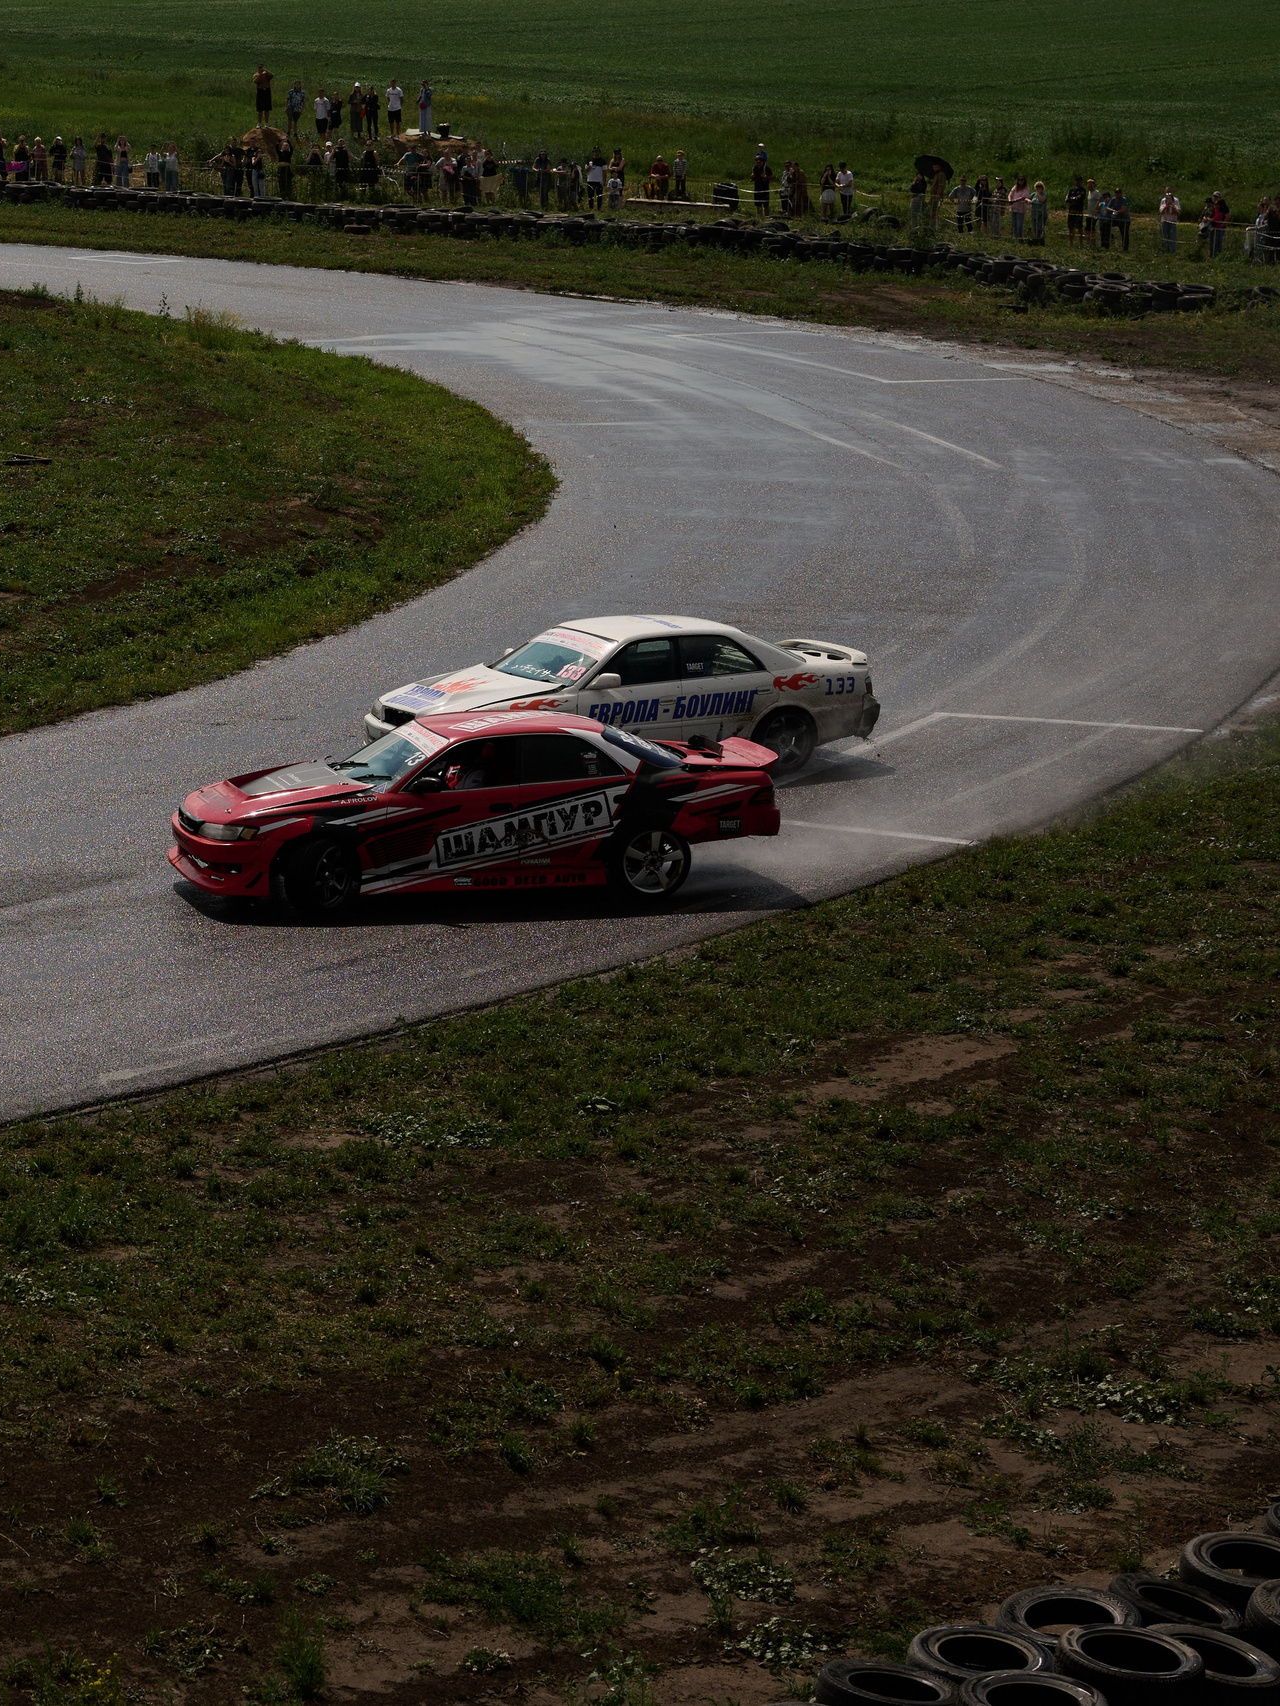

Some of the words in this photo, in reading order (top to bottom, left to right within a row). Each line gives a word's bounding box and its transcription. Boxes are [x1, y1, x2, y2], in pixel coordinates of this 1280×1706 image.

[556, 665, 586, 680] 133
[686, 662, 704, 671] TARGET
[825, 676, 855, 695] 133
[589, 698, 660, 726] ЕВРОПА
[672, 689, 758, 719] БОУЛИНГ
[404, 751, 426, 766] 13
[441, 800, 604, 861] ШАМПУР
[719, 820, 740, 829] TARGET
[554, 873, 586, 884] AUTO
